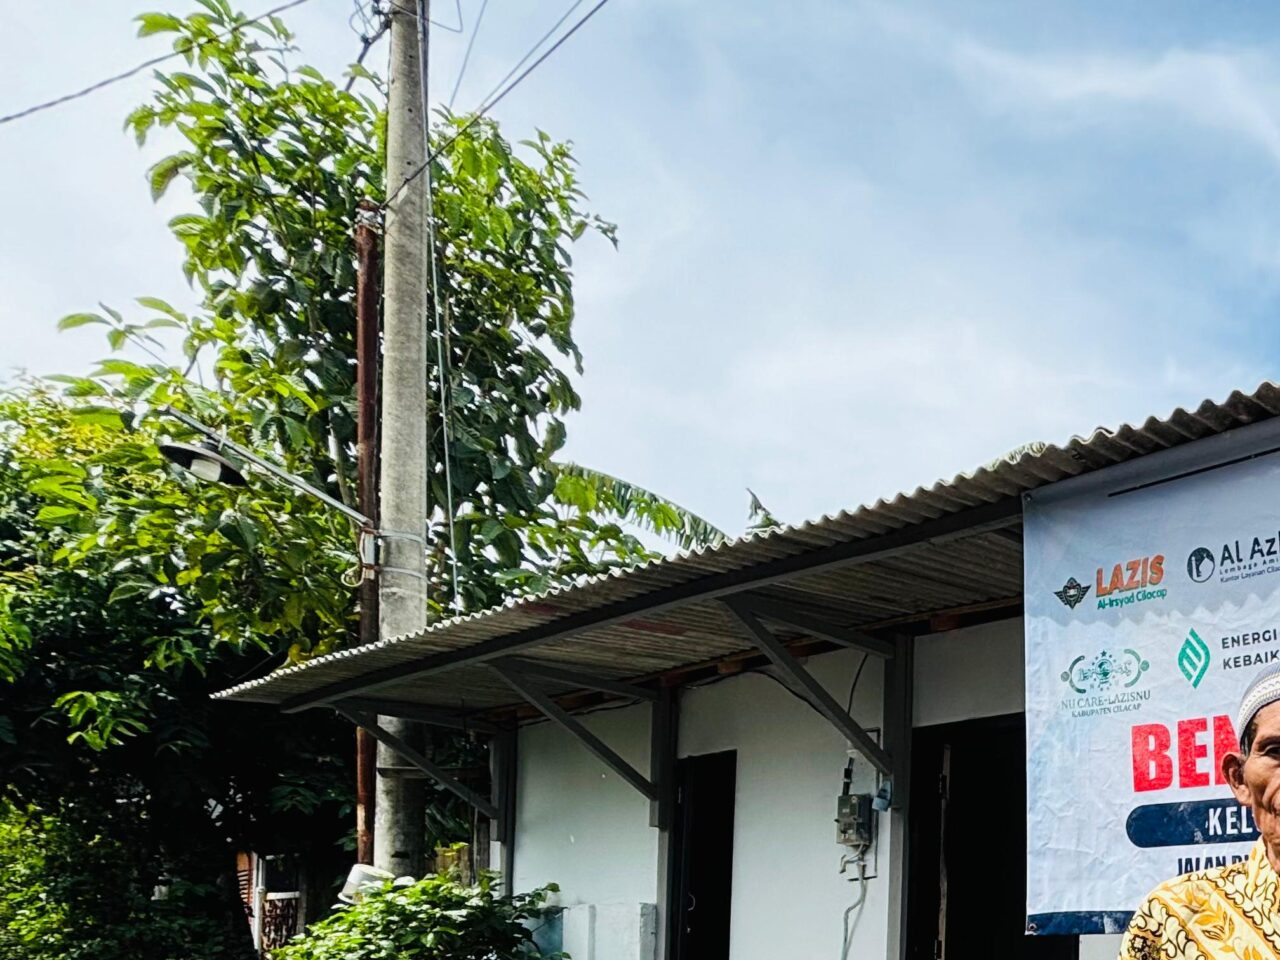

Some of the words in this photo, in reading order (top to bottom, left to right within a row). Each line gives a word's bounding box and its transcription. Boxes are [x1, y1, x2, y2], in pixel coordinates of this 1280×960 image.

[1220, 540, 1243, 567] Al
[1095, 554, 1166, 598] LAZIS
[1219, 562, 1258, 575] Lembaga
[1097, 593, 1135, 610] Al-Irsyad
[1136, 588, 1168, 602] Cilacap
[1221, 629, 1278, 649] ENERGI
[1060, 699, 1076, 710] NU
[1077, 690, 1151, 709] CARE-LAZISNU
[1071, 706, 1112, 718] KABUPATEN
[1112, 703, 1142, 714] CILACAP
